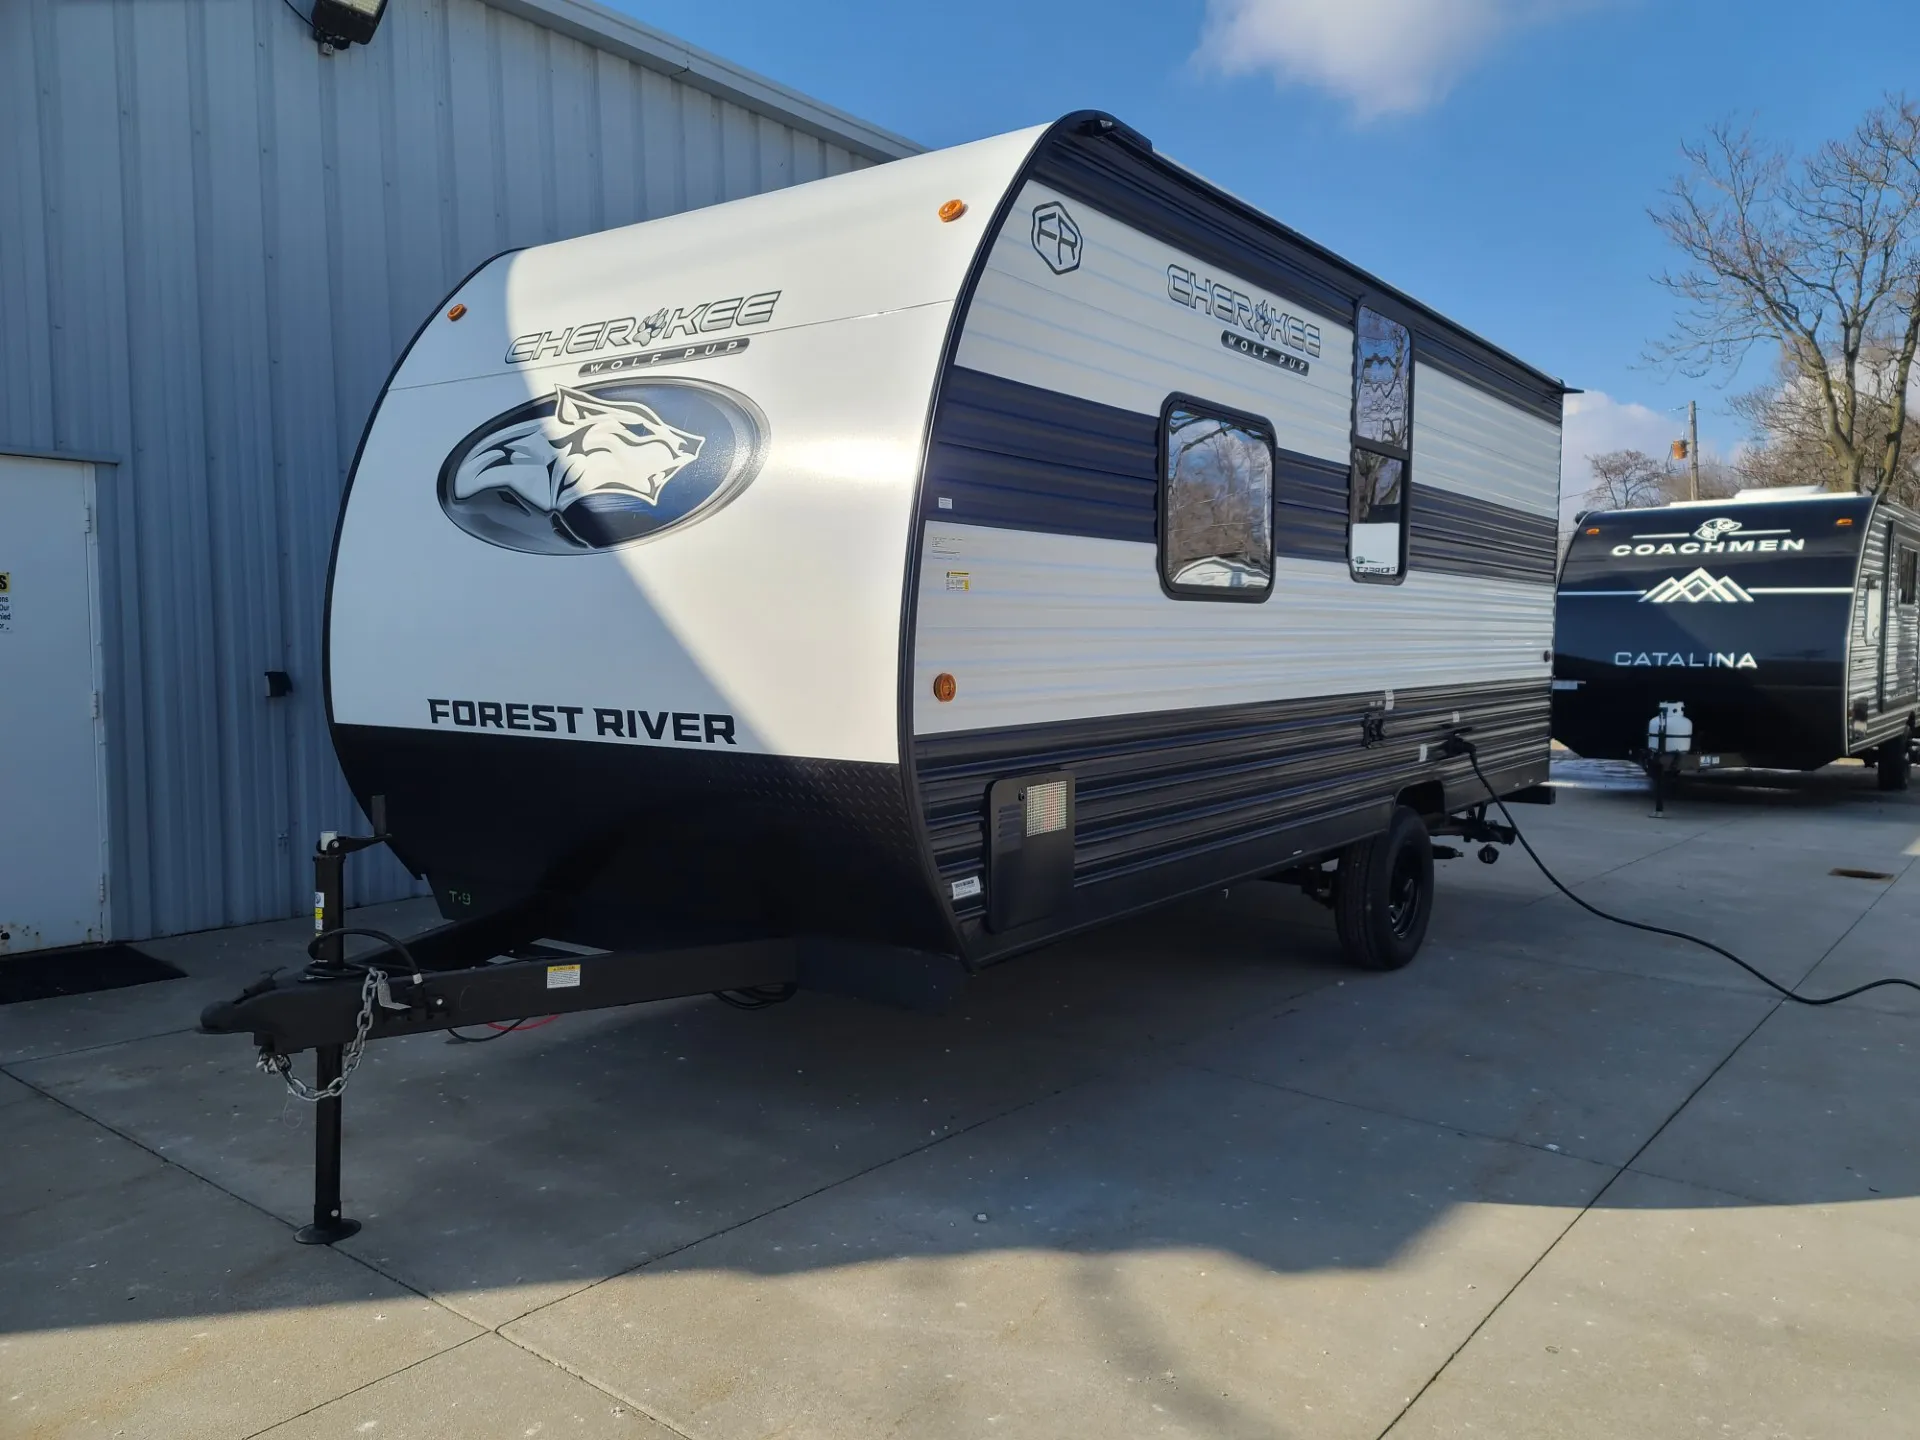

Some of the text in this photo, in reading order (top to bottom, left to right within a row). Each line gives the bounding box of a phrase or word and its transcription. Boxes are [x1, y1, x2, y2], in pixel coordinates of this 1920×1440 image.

[589, 341, 738, 374] WOLF PUP
[1227, 334, 1306, 373] WOLF PUP
[1611, 538, 1805, 557] COACHMEN
[1614, 651, 1758, 669] CATALINA
[427, 698, 738, 745] FOREST RIVER
